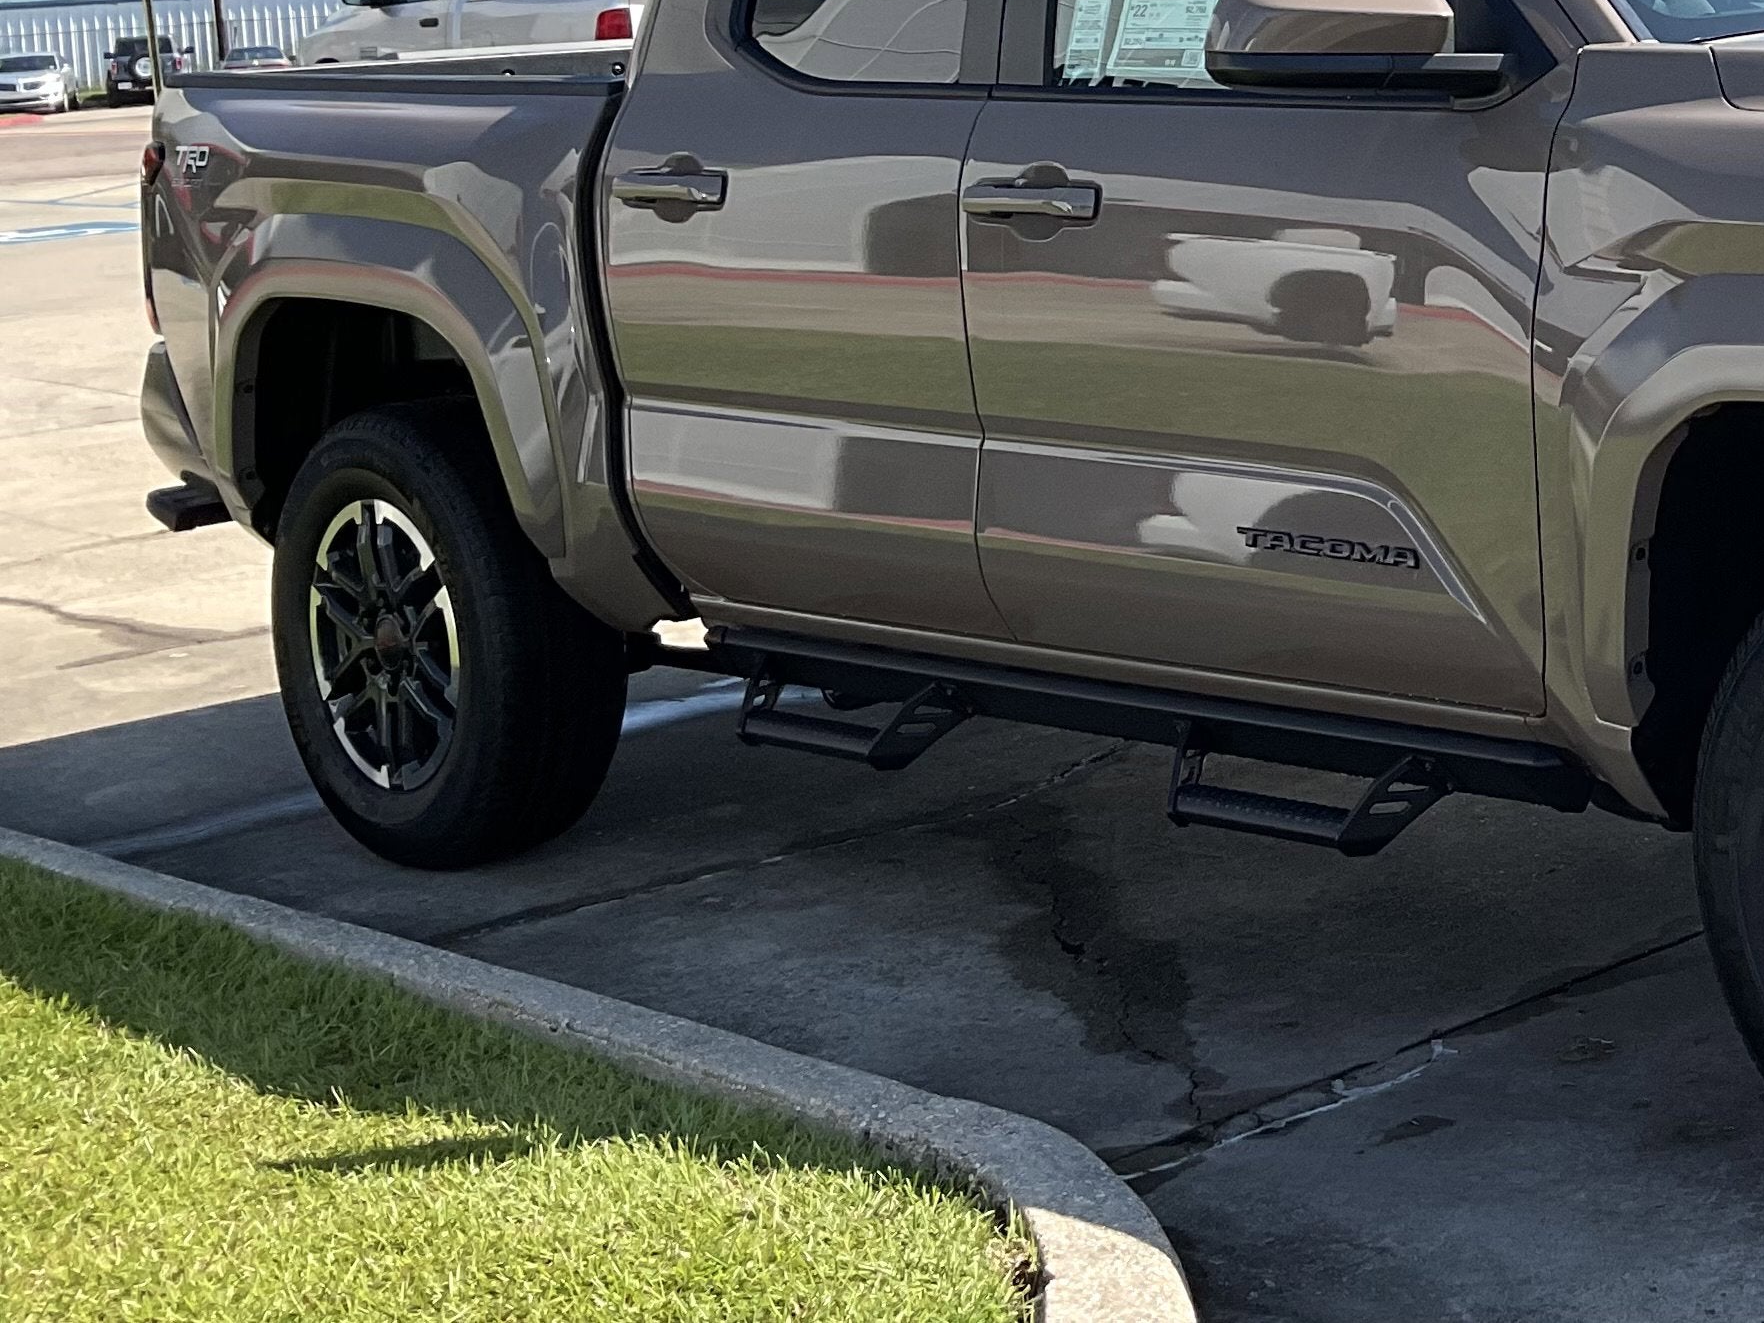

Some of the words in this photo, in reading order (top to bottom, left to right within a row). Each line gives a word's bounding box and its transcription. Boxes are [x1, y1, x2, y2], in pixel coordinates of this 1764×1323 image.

[1132, 4, 1149, 18] 22
[175, 145, 210, 174] TRD
[1236, 526, 1421, 570] TACOMA
